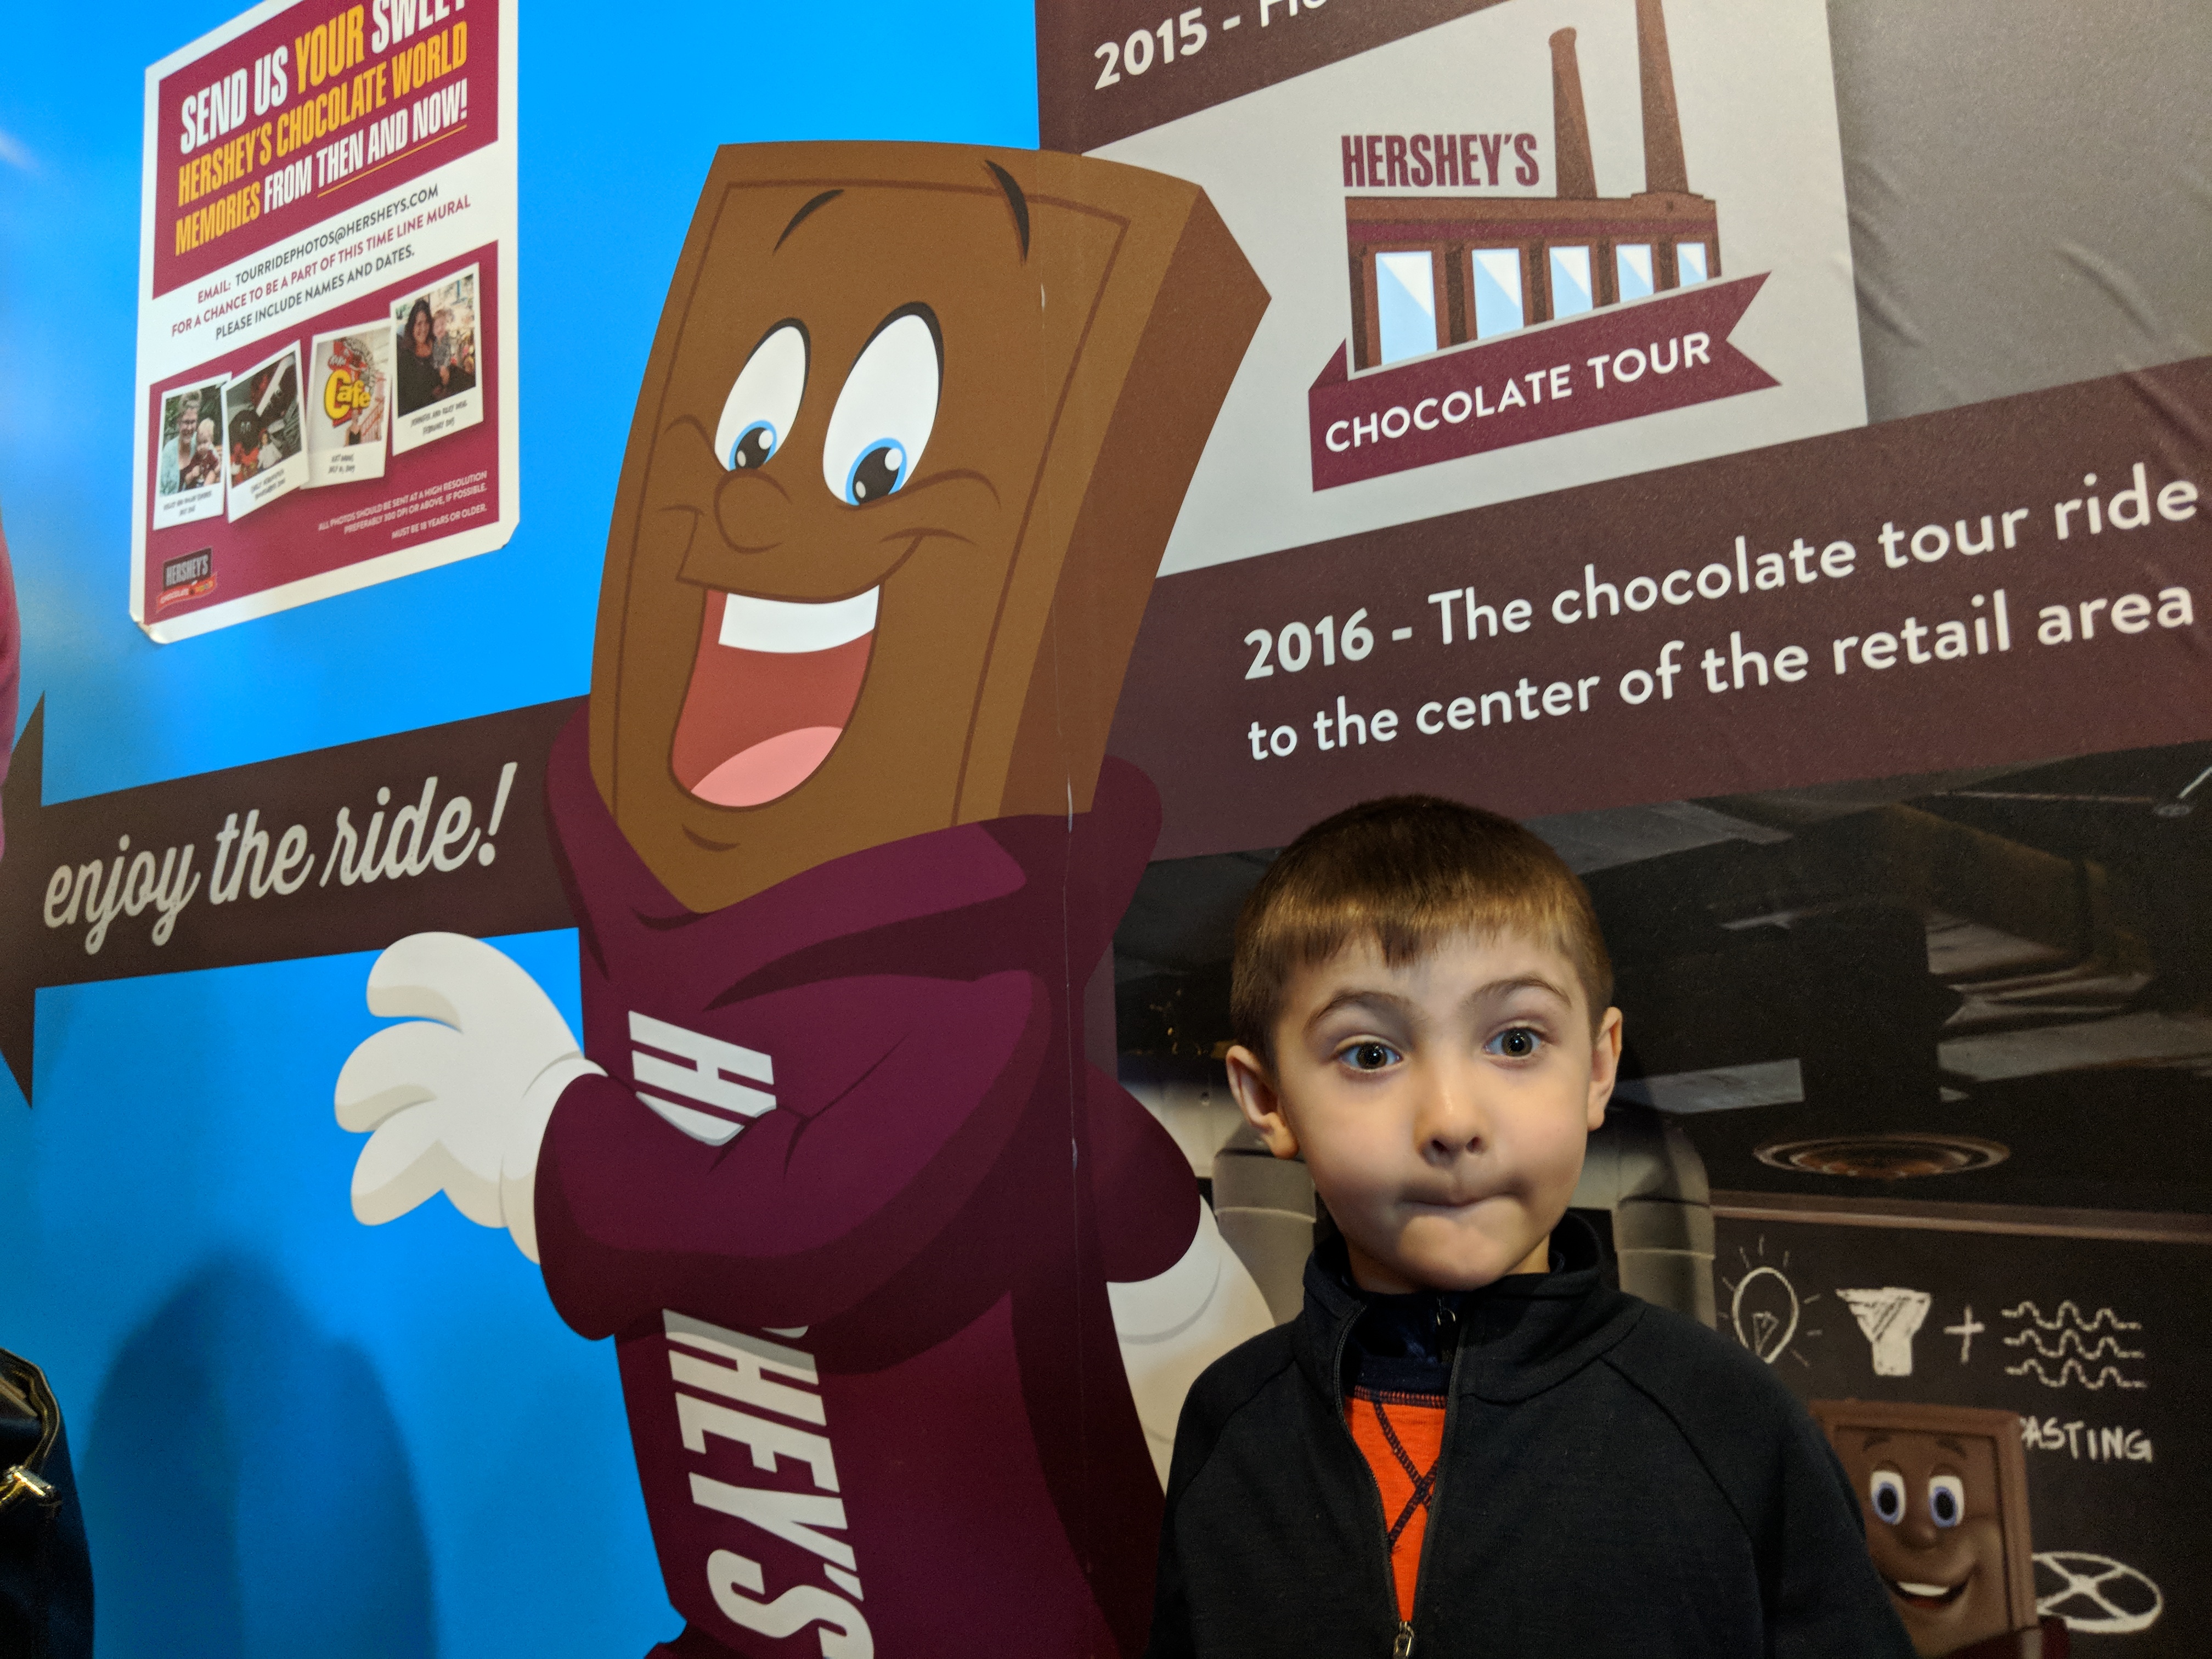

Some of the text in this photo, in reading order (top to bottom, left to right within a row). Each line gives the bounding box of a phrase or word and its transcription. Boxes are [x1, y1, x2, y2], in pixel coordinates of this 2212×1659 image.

[180, 67, 248, 154] SEND
[253, 45, 289, 115] US
[294, 3, 365, 94] YOUR
[1094, 7, 1207, 90] 2015
[174, 78, 467, 255] MEMORIES FROM THEN AND NOW!
[177, 20, 467, 207] HERSHEY'S CHOCOLATE WORLD
[1340, 132, 1540, 189] HERSHEY'S
[172, 193, 471, 336] FOR A CHANCE TO BE A PART OF THIS TIME LINE MURAL
[197, 183, 438, 303] EMAIL: TOURRIDEPHOTOS@HERSHEYS.COM
[216, 243, 415, 339] PLEASE INCLUDE NAMES AND DATES.
[1325, 331, 1711, 453] CHOCOLATE TOUR
[392, 495, 409, 507] SENT
[442, 470, 487, 490] RESOLUTION
[427, 515, 449, 528] YEARS
[1244, 607, 1374, 680] 2016
[1427, 586, 1533, 645] The
[1551, 535, 1857, 624] chocolate
[1878, 508, 2029, 568] tour
[2054, 462, 2198, 540] ride
[1247, 586, 2194, 760] to the center of the retail area
[43, 761, 518, 955] enjoy the ride!
[2019, 1415, 2153, 1463] ASTING
